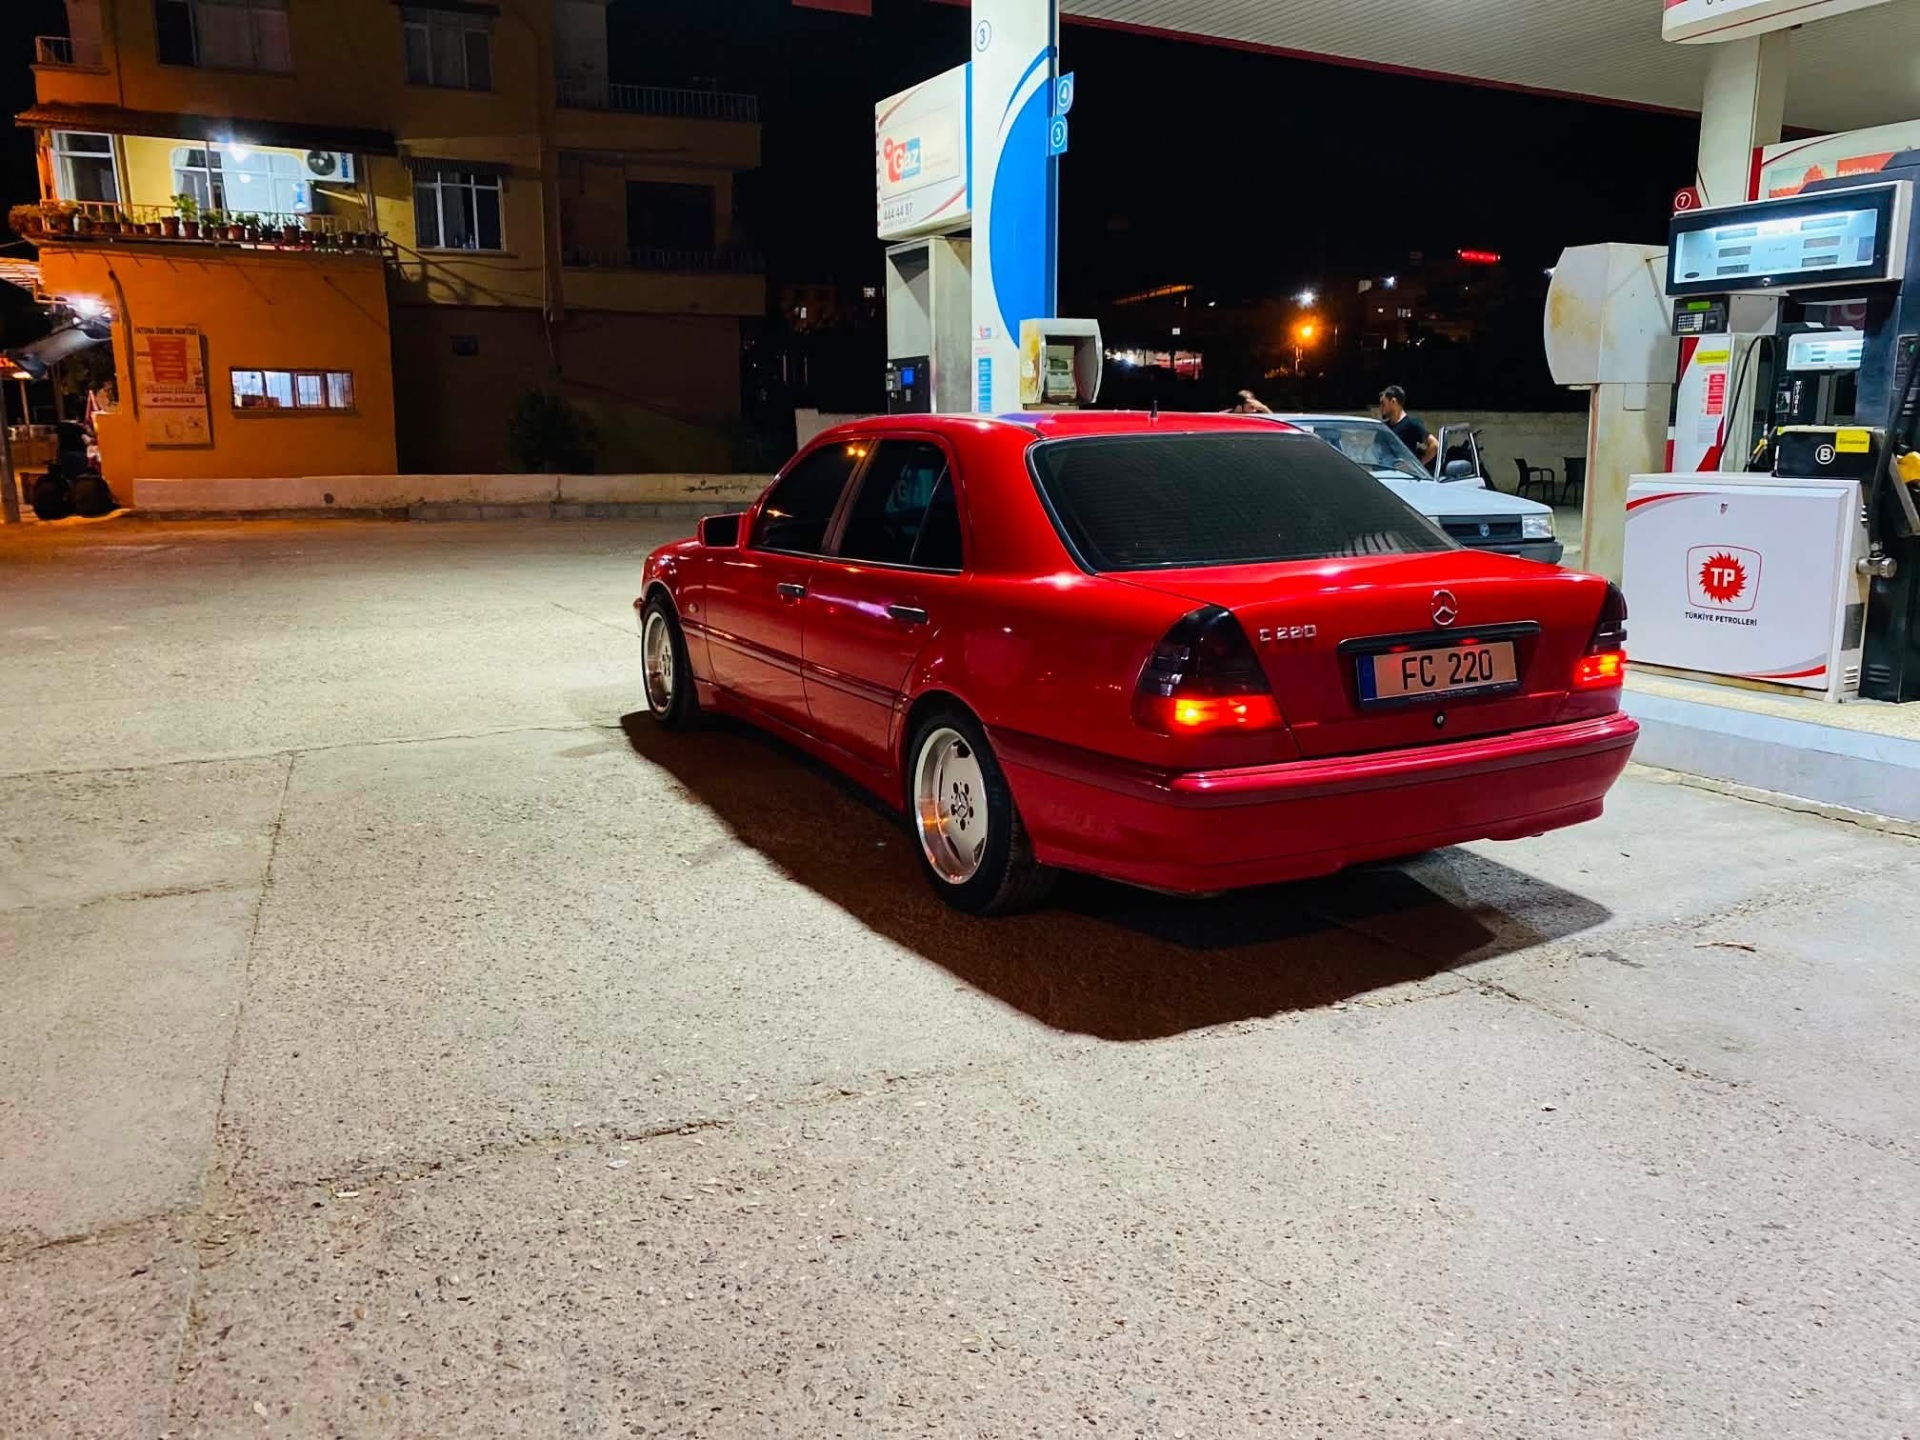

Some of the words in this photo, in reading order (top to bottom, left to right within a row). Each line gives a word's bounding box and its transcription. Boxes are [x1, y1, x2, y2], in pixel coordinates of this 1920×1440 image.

[979, 28, 986, 45] 3
[1061, 85, 1068, 98] 4
[1055, 124, 1061, 138] 3
[893, 148, 920, 174] Gaz
[1679, 195, 1687, 206] 7
[884, 207, 895, 220] 444
[1819, 448, 1831, 461] B
[1710, 567, 1736, 587] TP
[1685, 611, 1714, 622] TÜRKİYE
[1715, 615, 1758, 626] PETROLLERİ
[1259, 628, 1272, 641] C
[1276, 624, 1317, 640] 220
[1401, 655, 1436, 690] FC
[1447, 649, 1493, 684] 220
